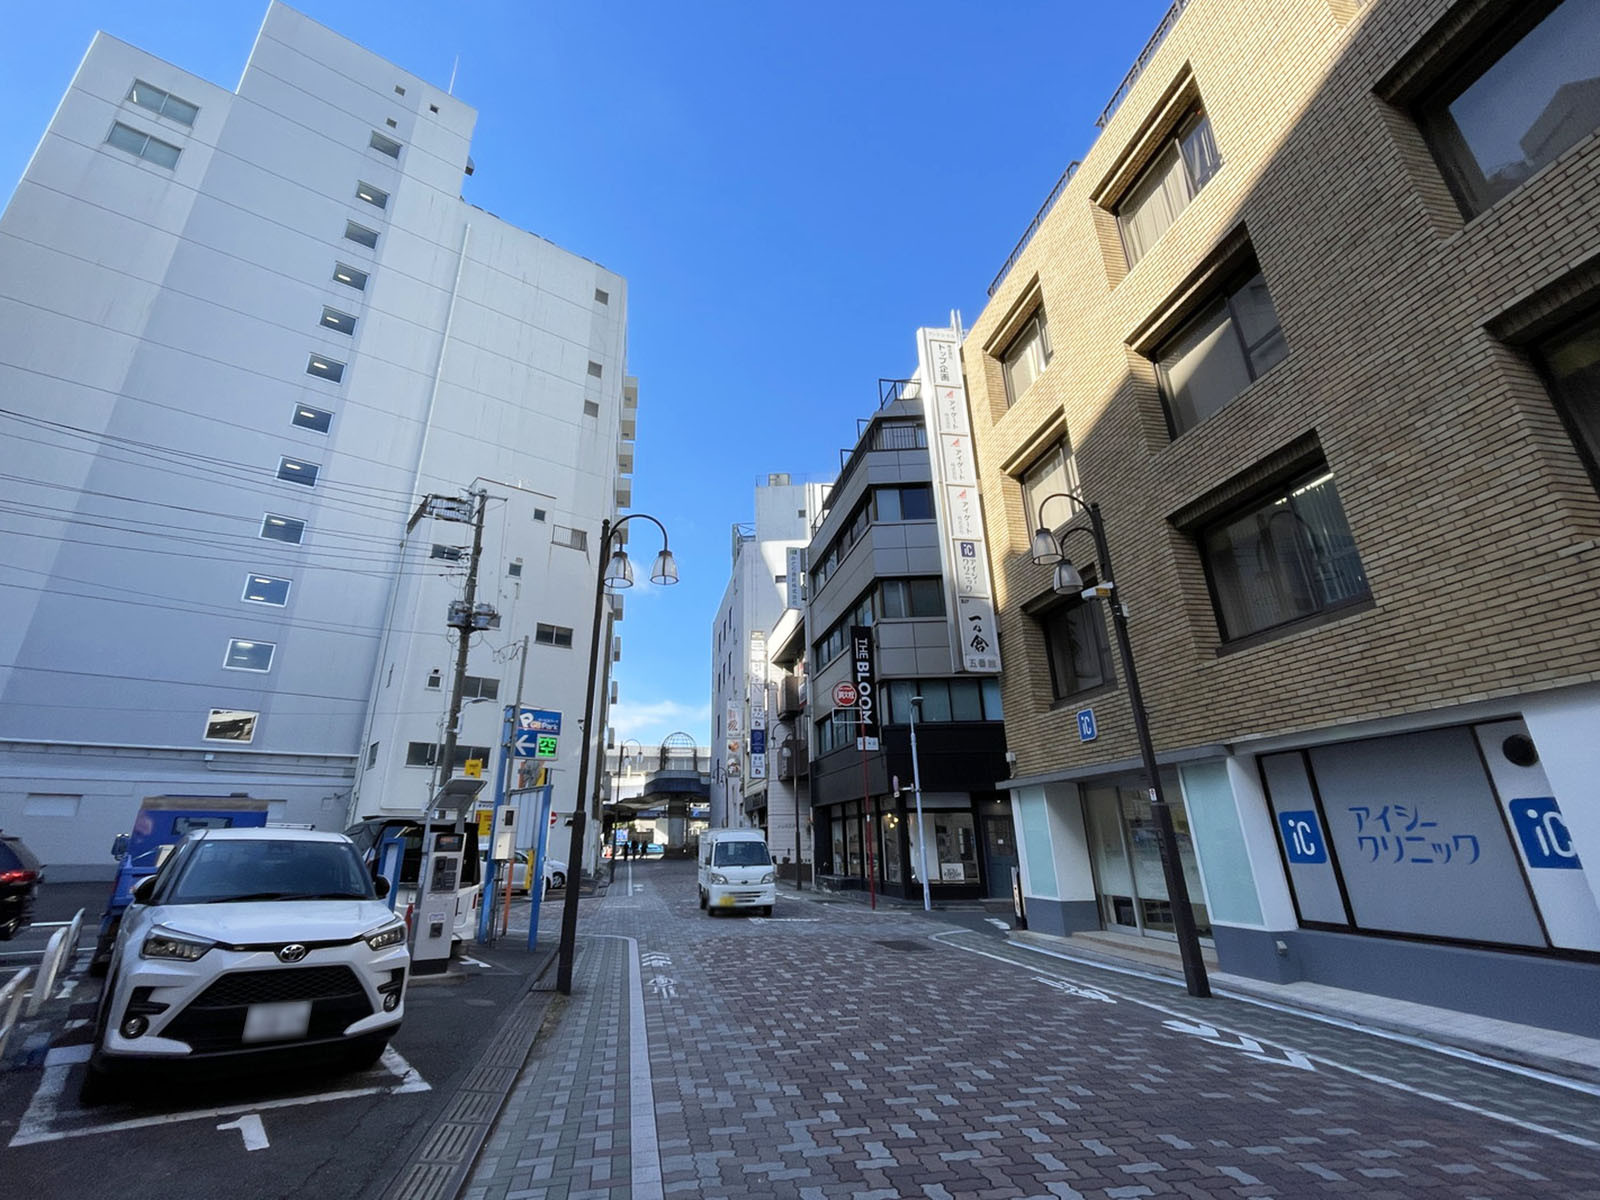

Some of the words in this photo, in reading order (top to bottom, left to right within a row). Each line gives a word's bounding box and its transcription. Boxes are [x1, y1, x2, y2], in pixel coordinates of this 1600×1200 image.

[938, 343, 950, 382] トップ企画
[962, 558, 973, 593] クリニック
[857, 637, 869, 660] THE
[857, 661, 873, 725] BLOOM
[537, 737, 558, 758] 空
[1348, 805, 1438, 833] アイシー
[1358, 835, 1481, 865] クリニック
